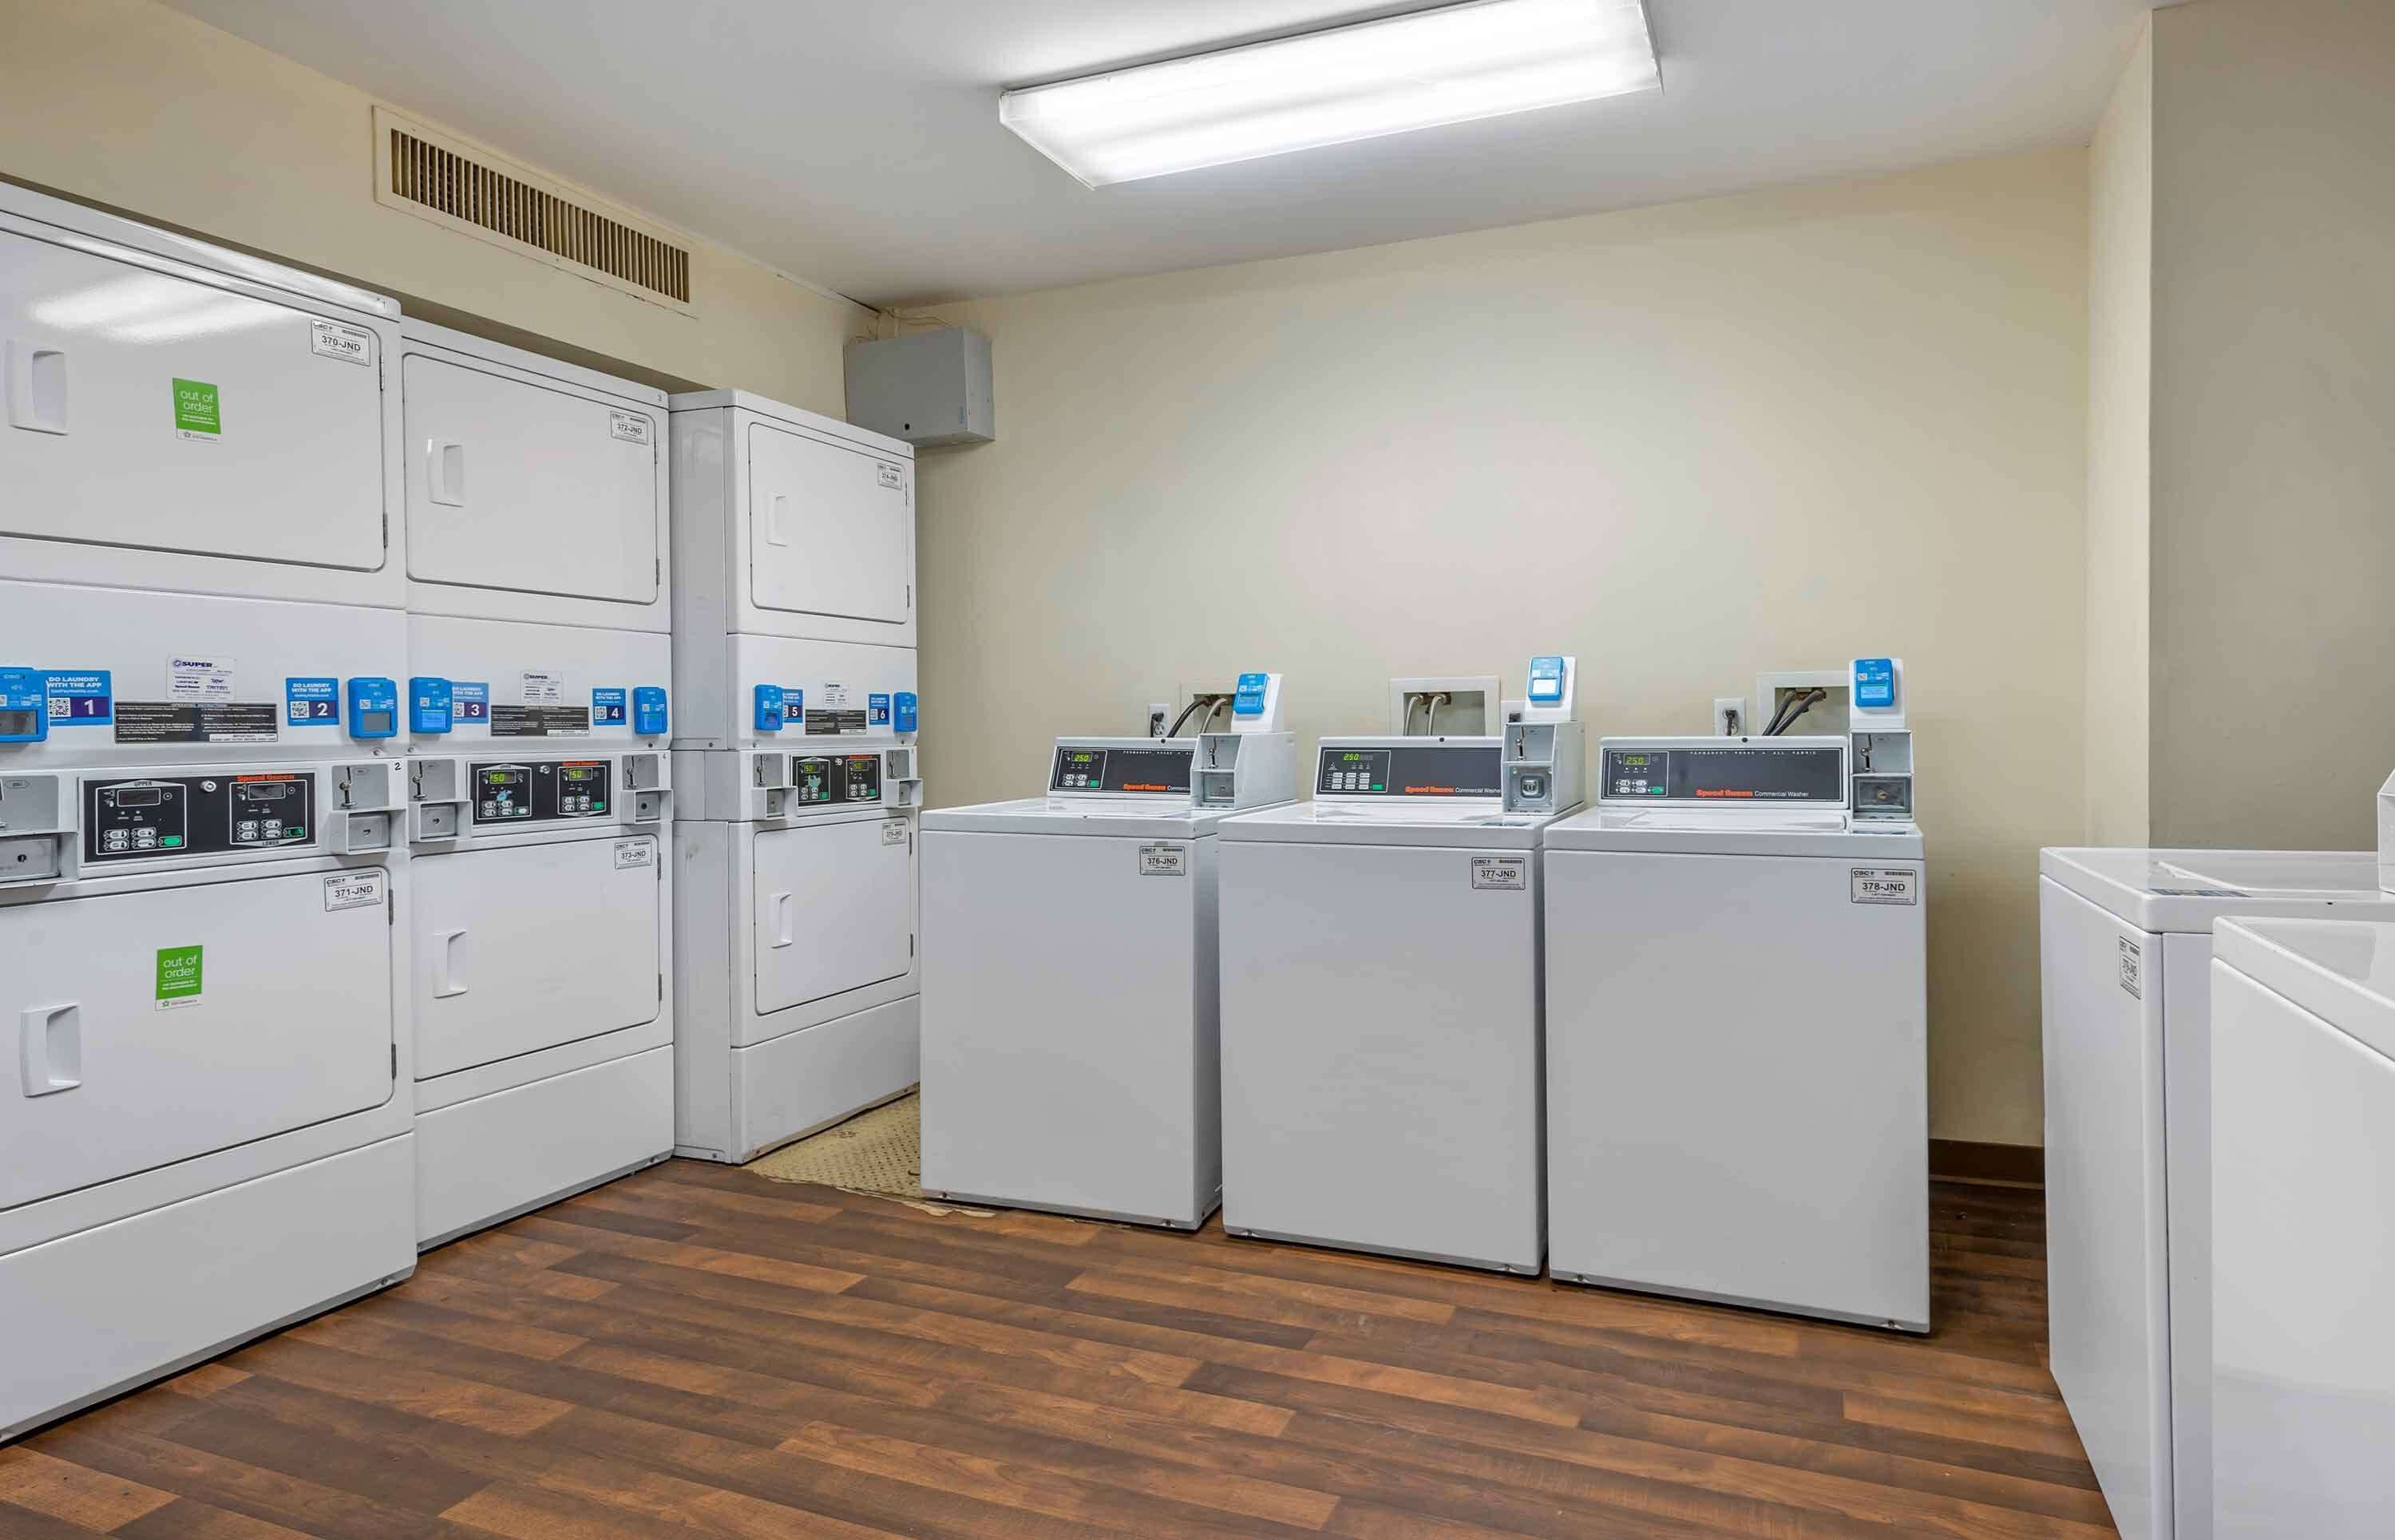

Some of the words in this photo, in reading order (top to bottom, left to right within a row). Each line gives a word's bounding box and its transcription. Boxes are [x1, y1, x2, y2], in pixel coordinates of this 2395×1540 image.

[321, 335, 361, 351] 370-JND
[180, 390, 199, 401] out
[203, 394, 213, 402] of
[184, 402, 213, 414] order
[84, 699, 94, 715] 1
[317, 703, 328, 716] 2
[471, 704, 480, 716] 3
[610, 707, 620, 719] 4
[791, 705, 798, 717] 5
[881, 710, 886, 719] 6
[394, 762, 402, 771] 2
[620, 850, 646, 859] 373-JND
[335, 885, 374, 898] 371-JND
[1862, 882, 1906, 892] 378-JND
[163, 957, 182, 968] out
[186, 954, 197, 965] of
[164, 967, 196, 979] order
